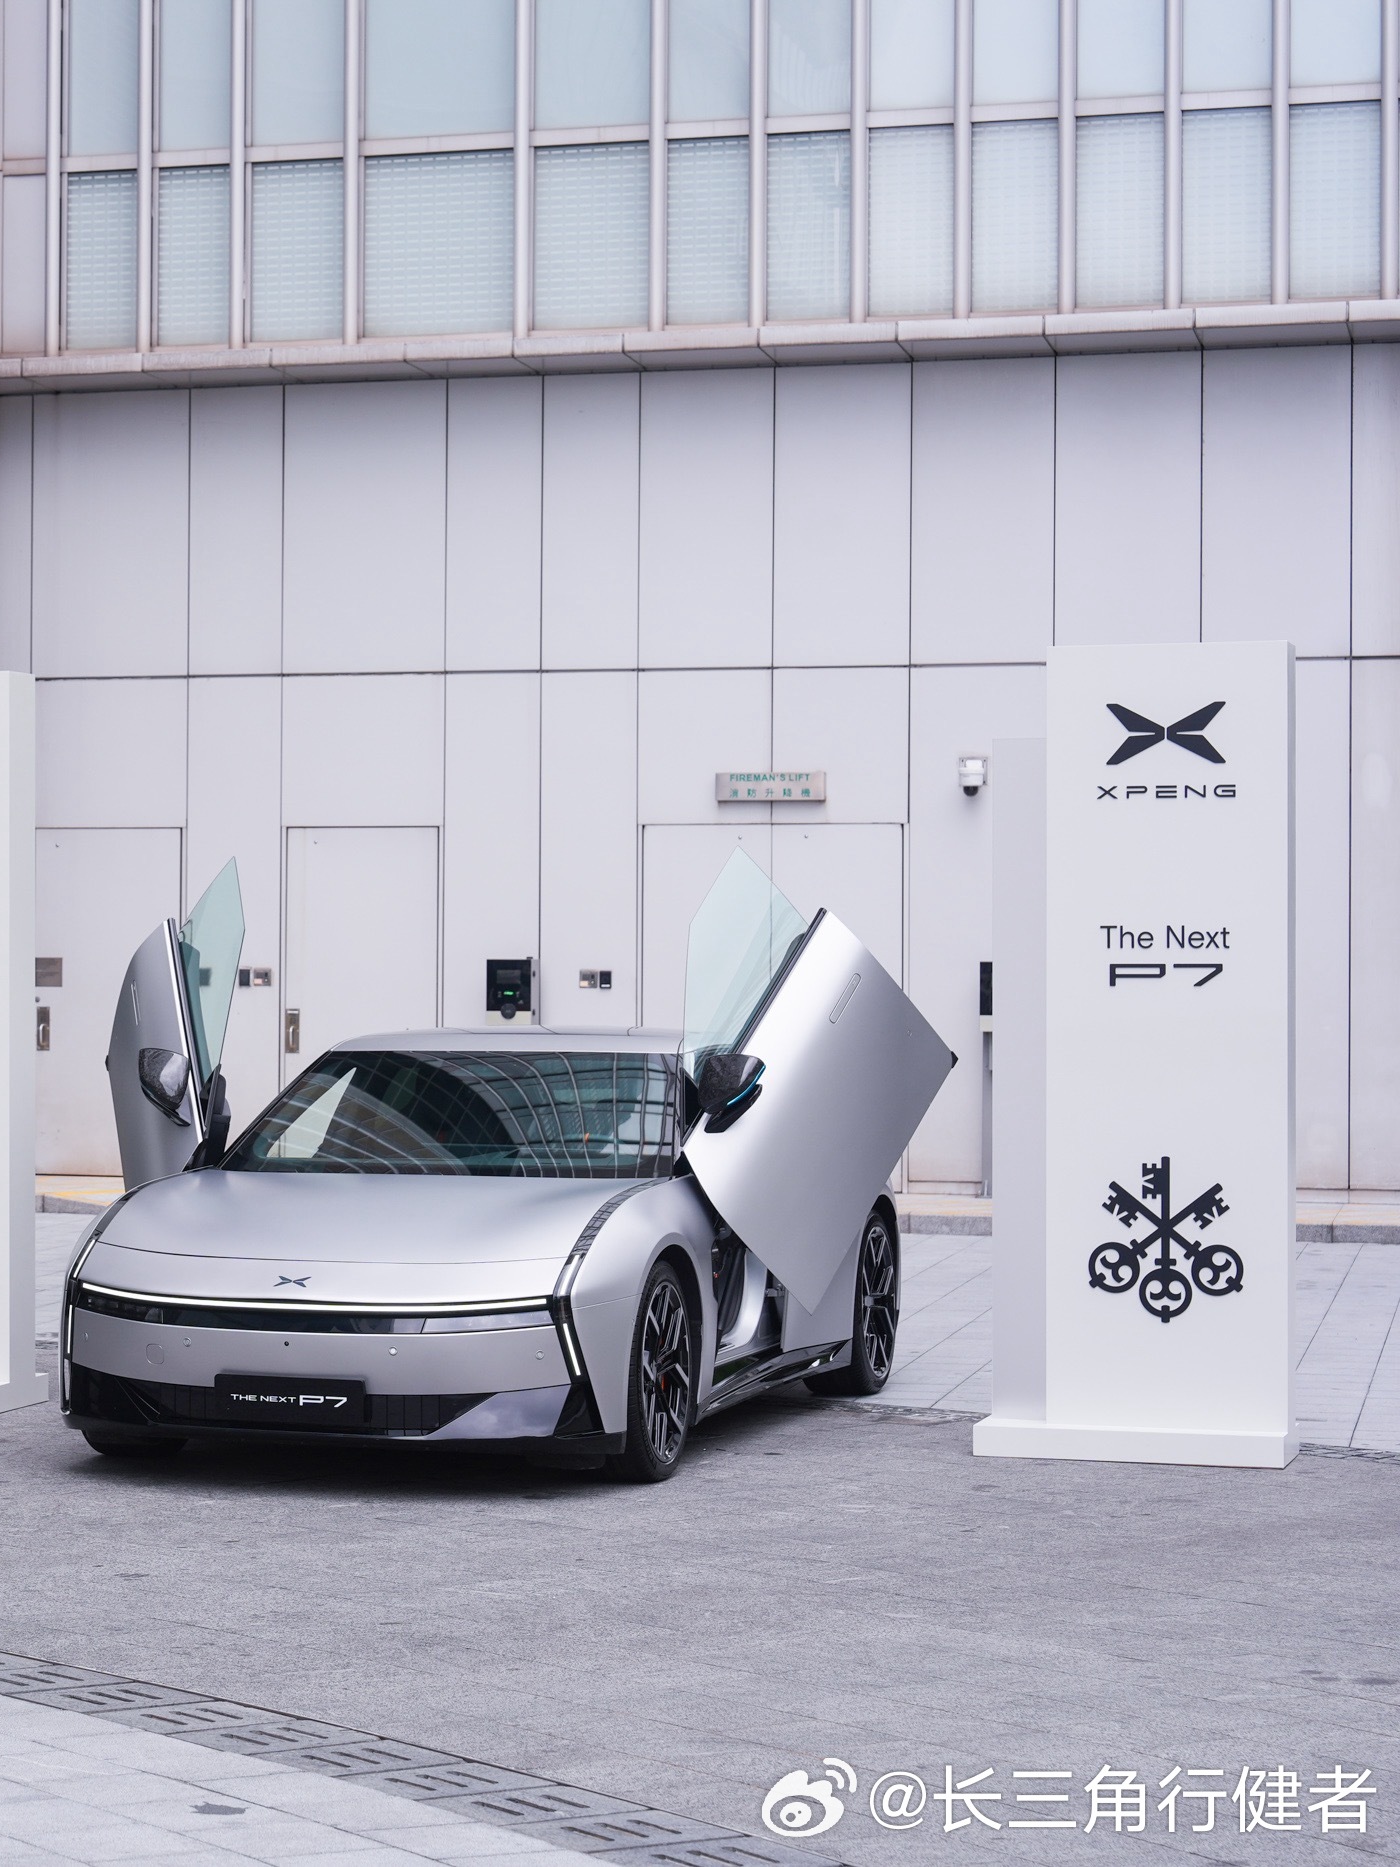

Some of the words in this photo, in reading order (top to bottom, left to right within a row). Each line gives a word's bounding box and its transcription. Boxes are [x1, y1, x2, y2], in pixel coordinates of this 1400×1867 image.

[729, 773, 786, 782] FIREMAN'S
[788, 773, 811, 782] LIFT
[1096, 784, 1237, 800] XPENG
[1099, 925, 1154, 950] The
[1166, 924, 1231, 950] Next
[1109, 963, 1224, 987] P7
[230, 1393, 258, 1402] THE
[259, 1395, 297, 1403] NEXT
[299, 1394, 348, 1408] P7
